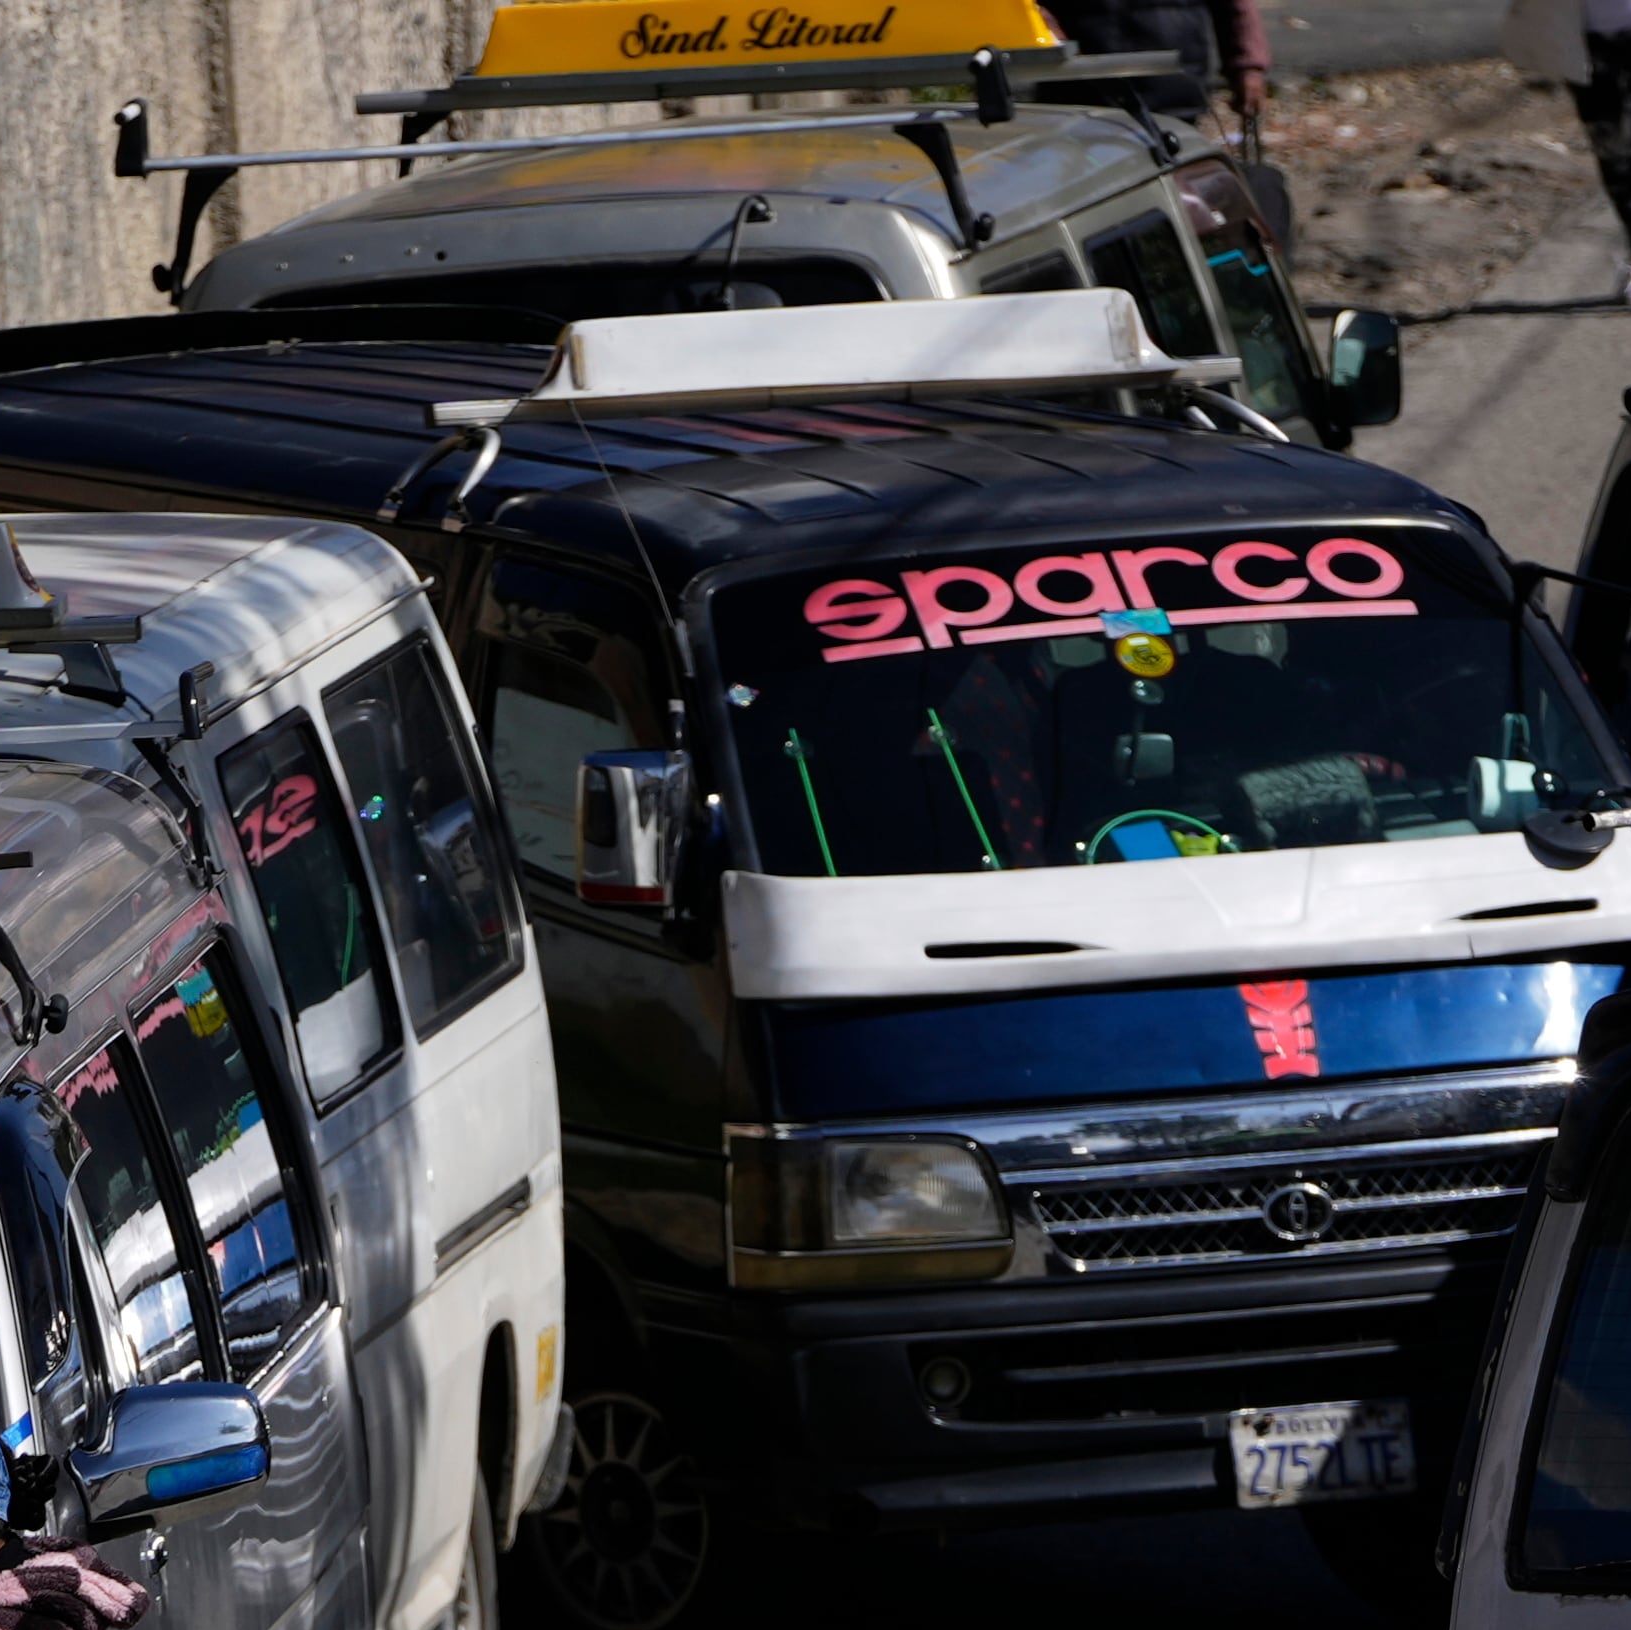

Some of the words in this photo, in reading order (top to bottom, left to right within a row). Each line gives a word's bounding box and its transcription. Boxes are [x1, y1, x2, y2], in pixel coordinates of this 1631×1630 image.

[620, 13, 728, 58] Sind.
[741, 6, 897, 50] Litoral
[803, 538, 1404, 649] sparco
